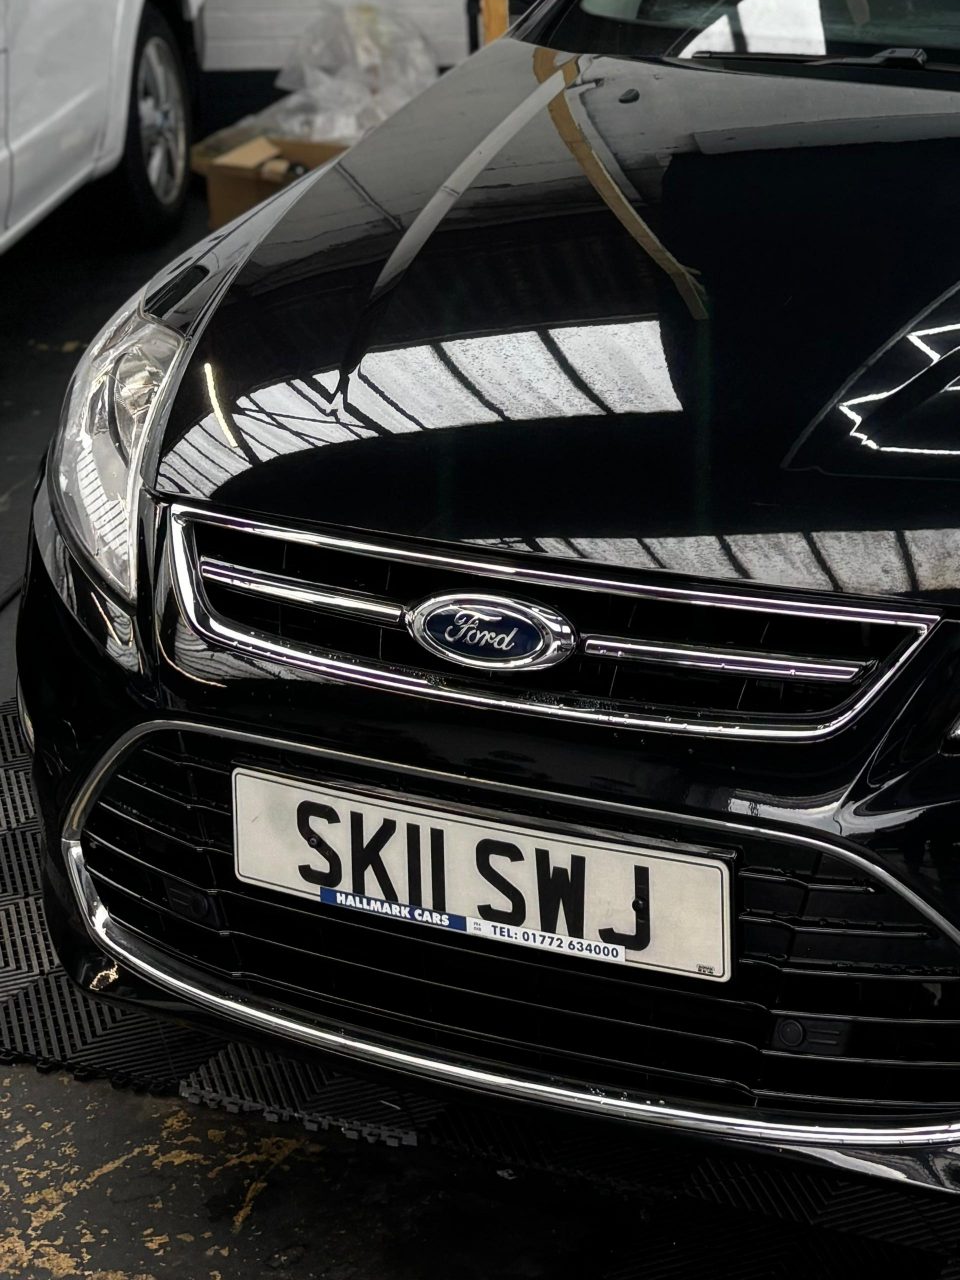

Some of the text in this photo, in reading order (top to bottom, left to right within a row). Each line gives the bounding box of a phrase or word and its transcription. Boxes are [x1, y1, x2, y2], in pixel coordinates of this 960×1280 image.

[444, 610, 518, 651] Ford
[298, 801, 651, 950] SK11 SWJ
[336, 893, 411, 917] HALLMARK
[414, 909, 450, 926] CARS
[491, 923, 519, 939] TEL:
[522, 932, 564, 949] 01772
[568, 940, 619, 959] 634000
